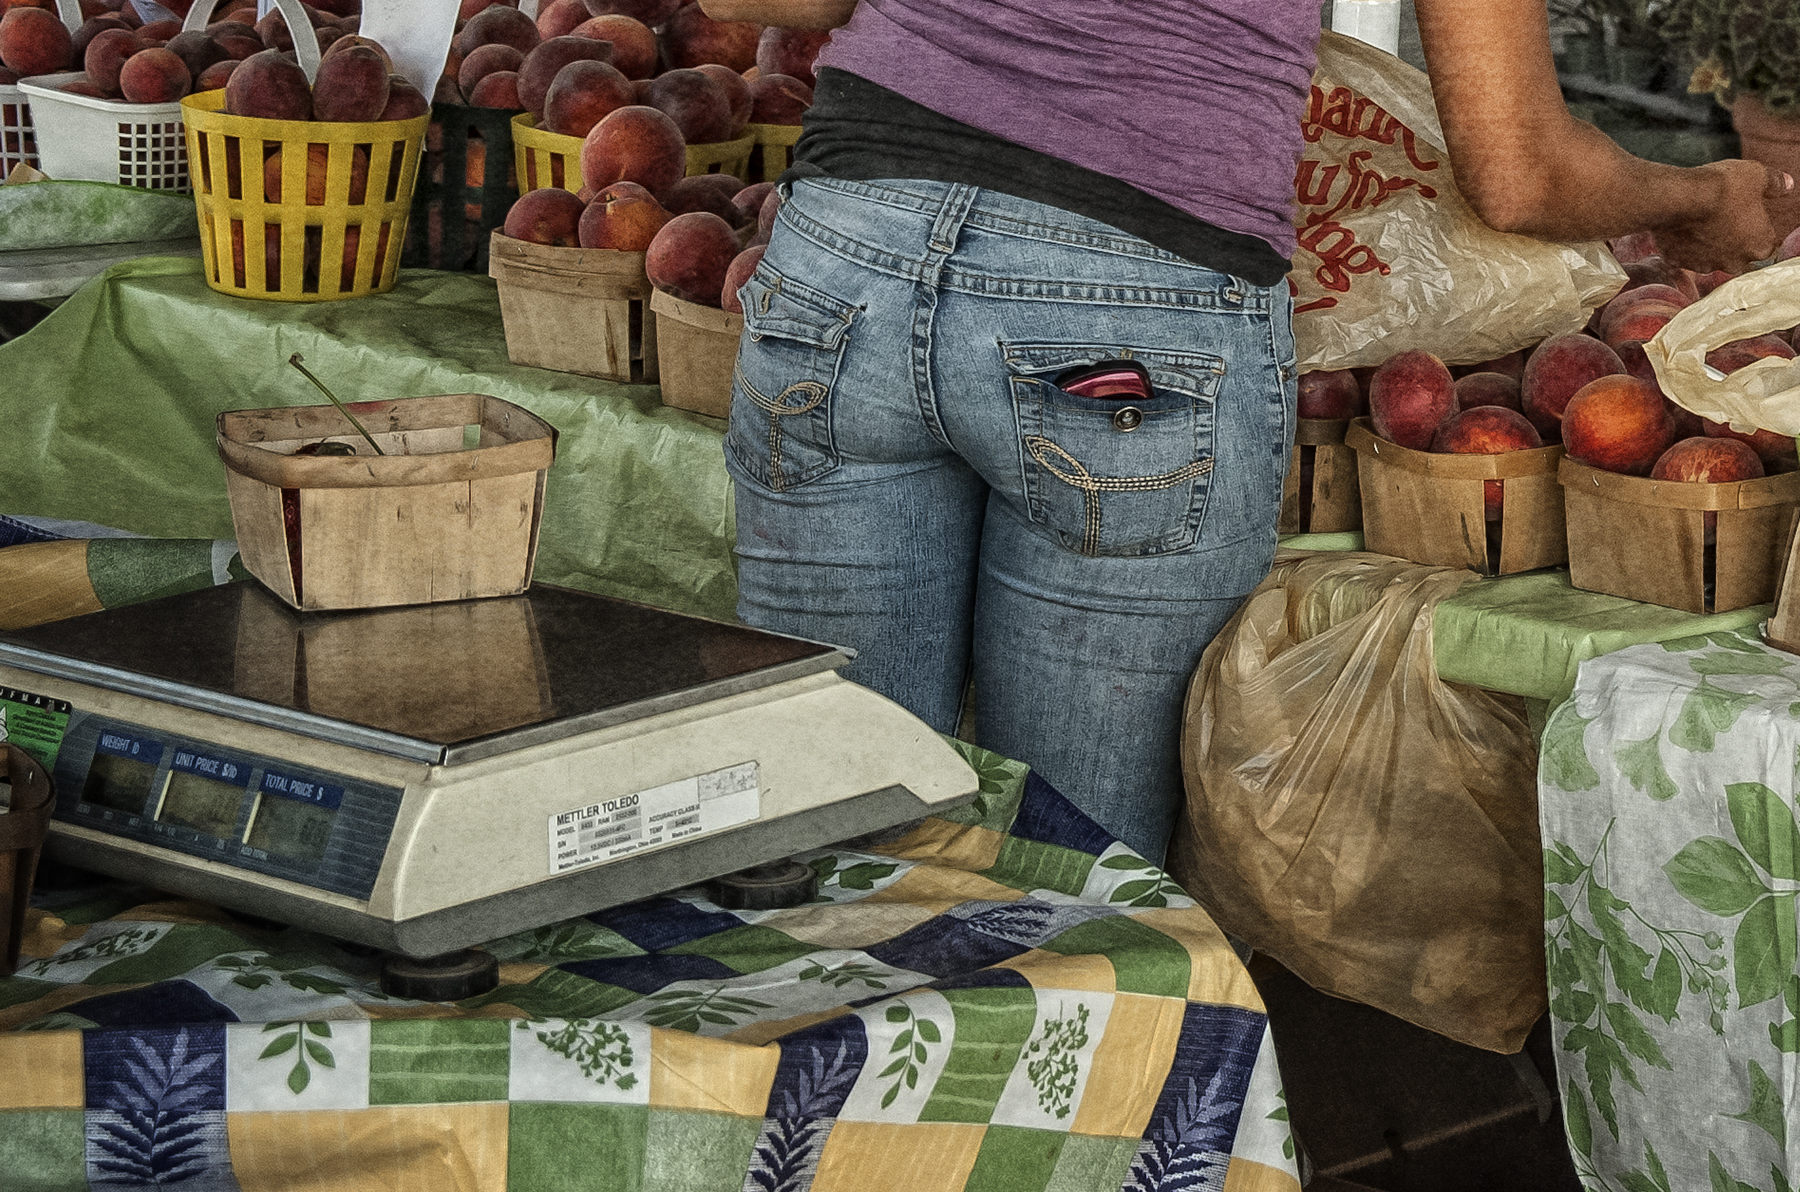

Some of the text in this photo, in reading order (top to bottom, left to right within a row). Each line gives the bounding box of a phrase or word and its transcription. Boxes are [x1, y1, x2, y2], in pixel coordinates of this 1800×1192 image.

[102, 734, 130, 751] WEIGHT
[176, 752, 195, 767] UNIT
[195, 757, 219, 774] PRICE
[265, 774, 324, 801] TOTAL PRICE $
[557, 794, 639, 826] METTLER TOLEDO
[649, 810, 677, 823] ACCURACY
[678, 806, 694, 815] CLASS
[557, 826, 576, 836] MODEL
[649, 825, 663, 835] TEMP
[558, 849, 577, 859] POWER
